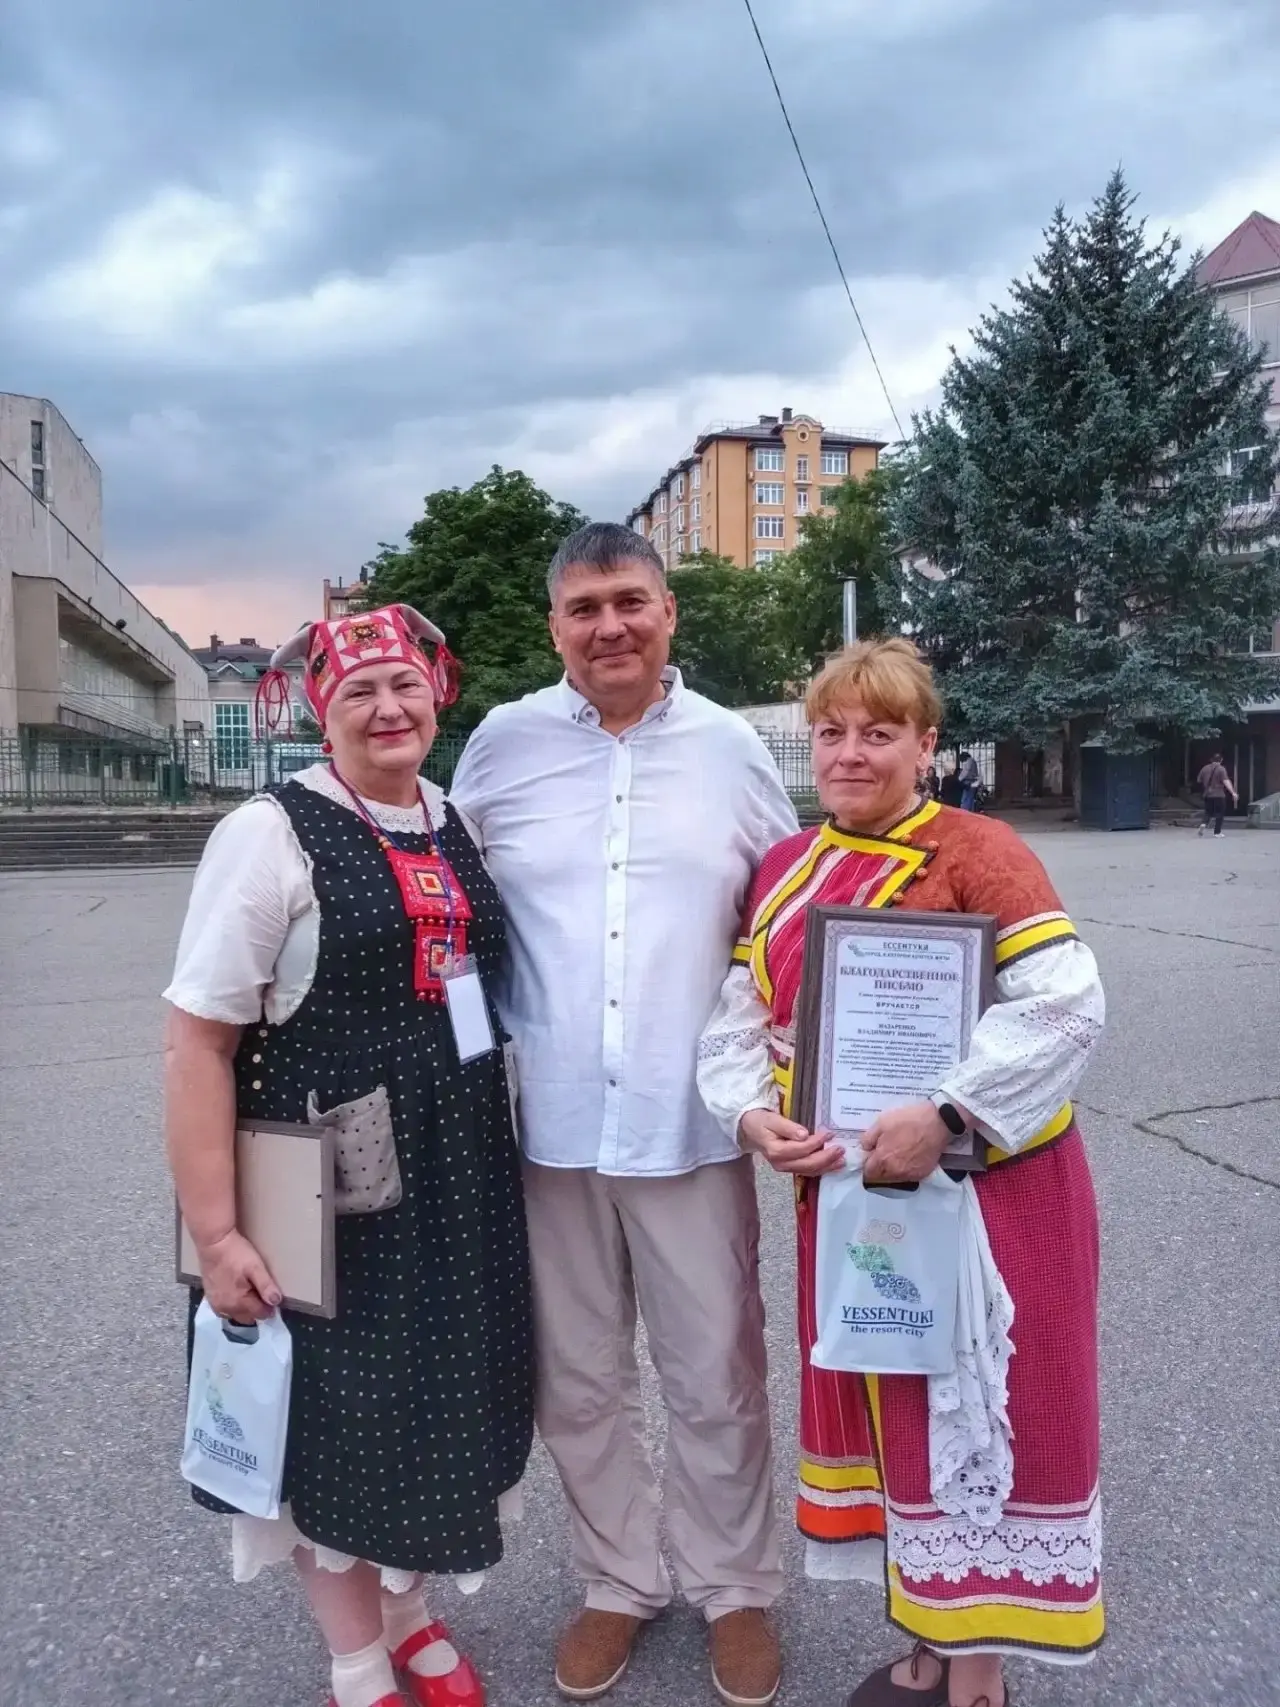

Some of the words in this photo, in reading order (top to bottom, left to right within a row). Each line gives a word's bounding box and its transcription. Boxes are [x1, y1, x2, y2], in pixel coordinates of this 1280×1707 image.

[883, 942, 929, 951] ЕССЕНТУКИ
[840, 966, 960, 982] БЛАГОДАРСТВЕННОЕ
[874, 980, 924, 992] ПИСЬМО
[876, 1002, 920, 1010] ВРУЧАЕТСЯ
[842, 1305, 934, 1324] YESSENTUKI
[850, 1325, 868, 1334] the
[871, 1326, 902, 1334] resort
[905, 1328, 926, 1339] city
